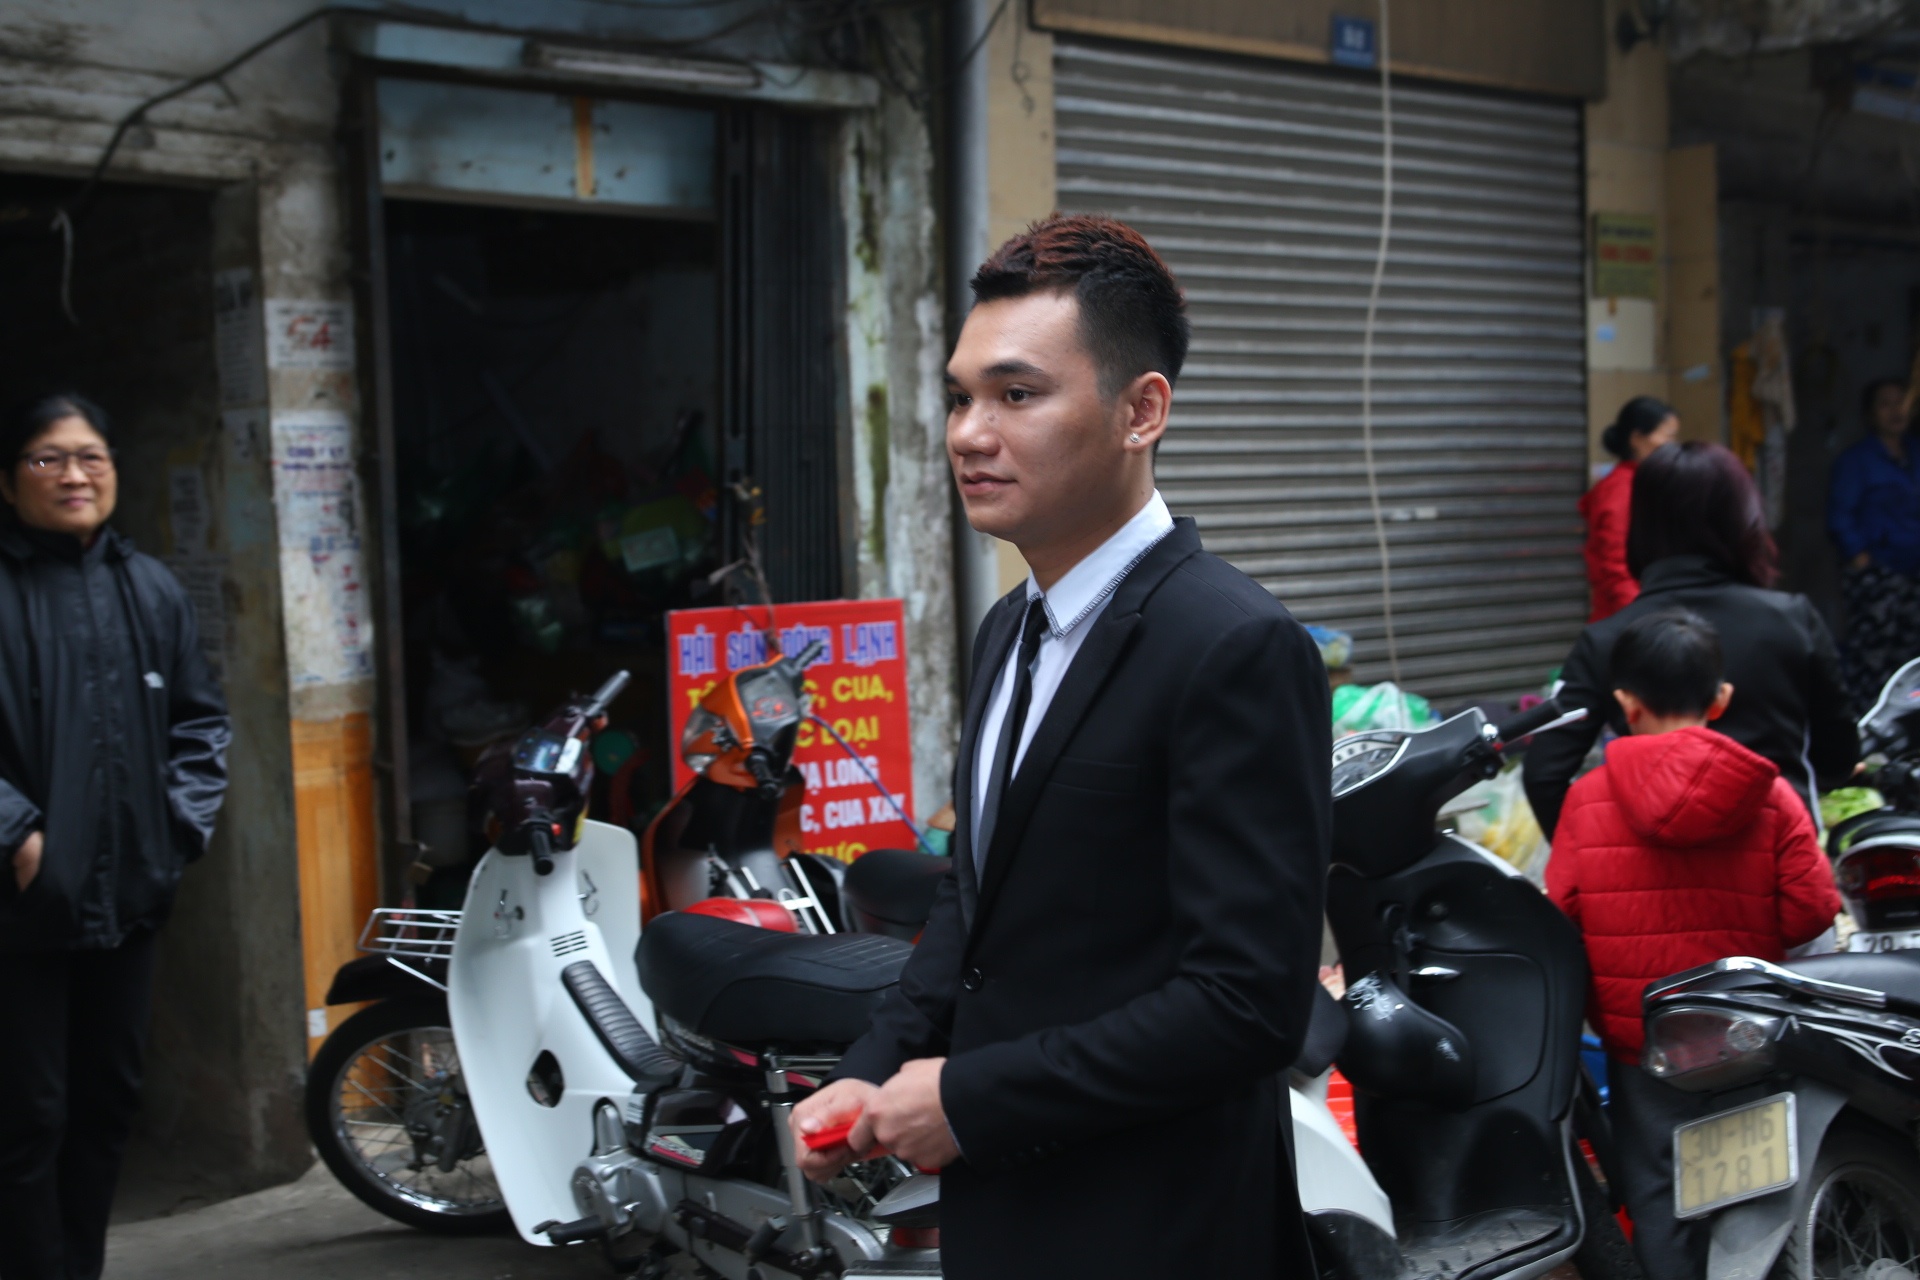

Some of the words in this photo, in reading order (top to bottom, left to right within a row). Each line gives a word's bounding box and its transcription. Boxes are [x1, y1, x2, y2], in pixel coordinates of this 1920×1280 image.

[841, 620, 898, 668] LẠNH
[832, 674, 894, 704] CUA,
[821, 715, 880, 749] LOẠI
[824, 755, 880, 788] LONG
[824, 798, 866, 830] CUA
[1692, 1146, 1777, 1204] 1281
